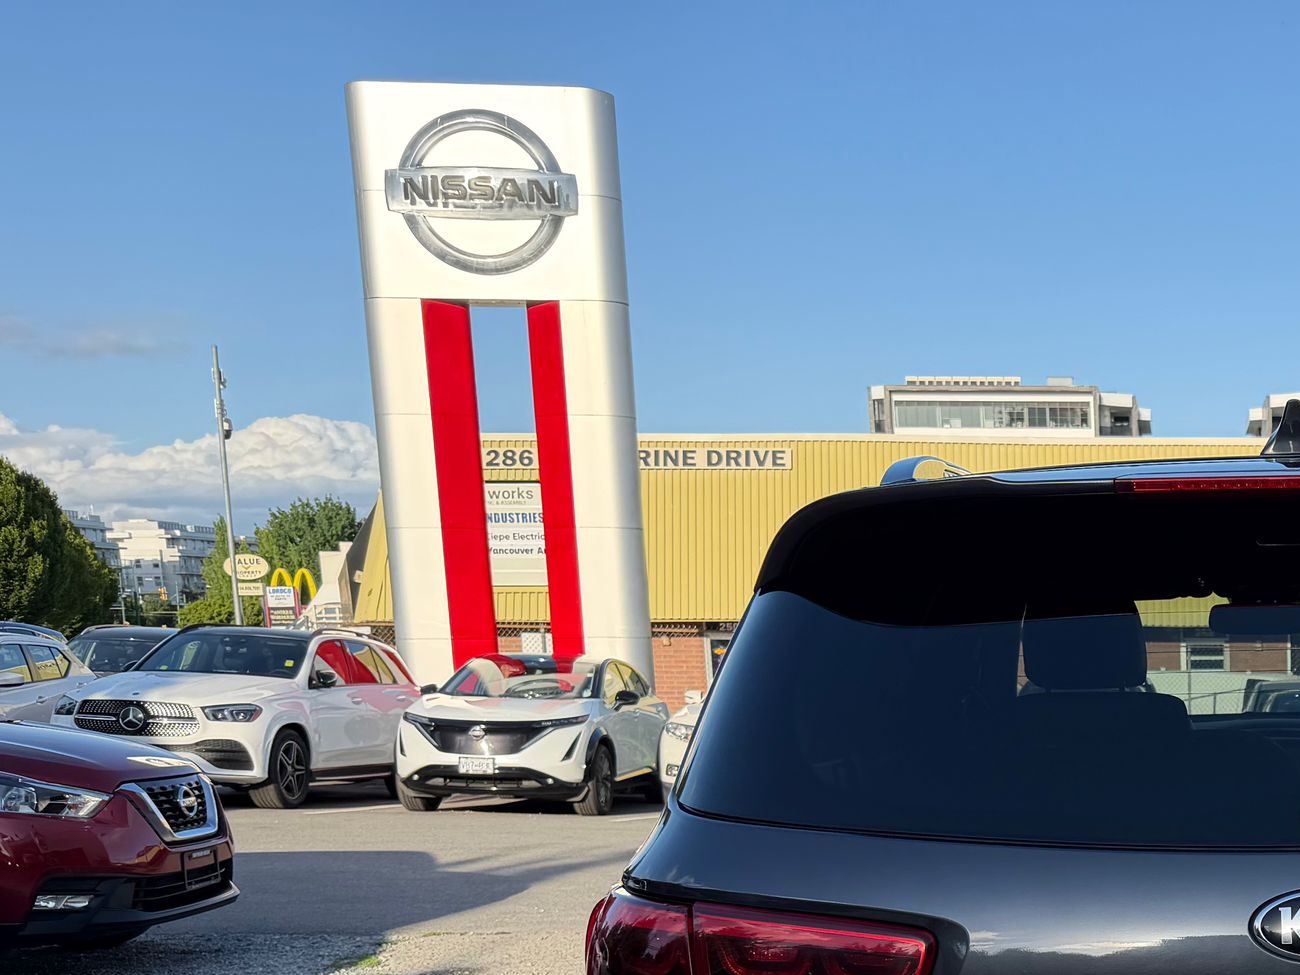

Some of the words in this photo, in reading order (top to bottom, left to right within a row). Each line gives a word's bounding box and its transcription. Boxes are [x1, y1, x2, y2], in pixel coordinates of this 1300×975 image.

[402, 174, 558, 206] NISSAN
[485, 449, 534, 467] 286
[706, 449, 786, 467] DRIVE
[488, 487, 534, 500] works
